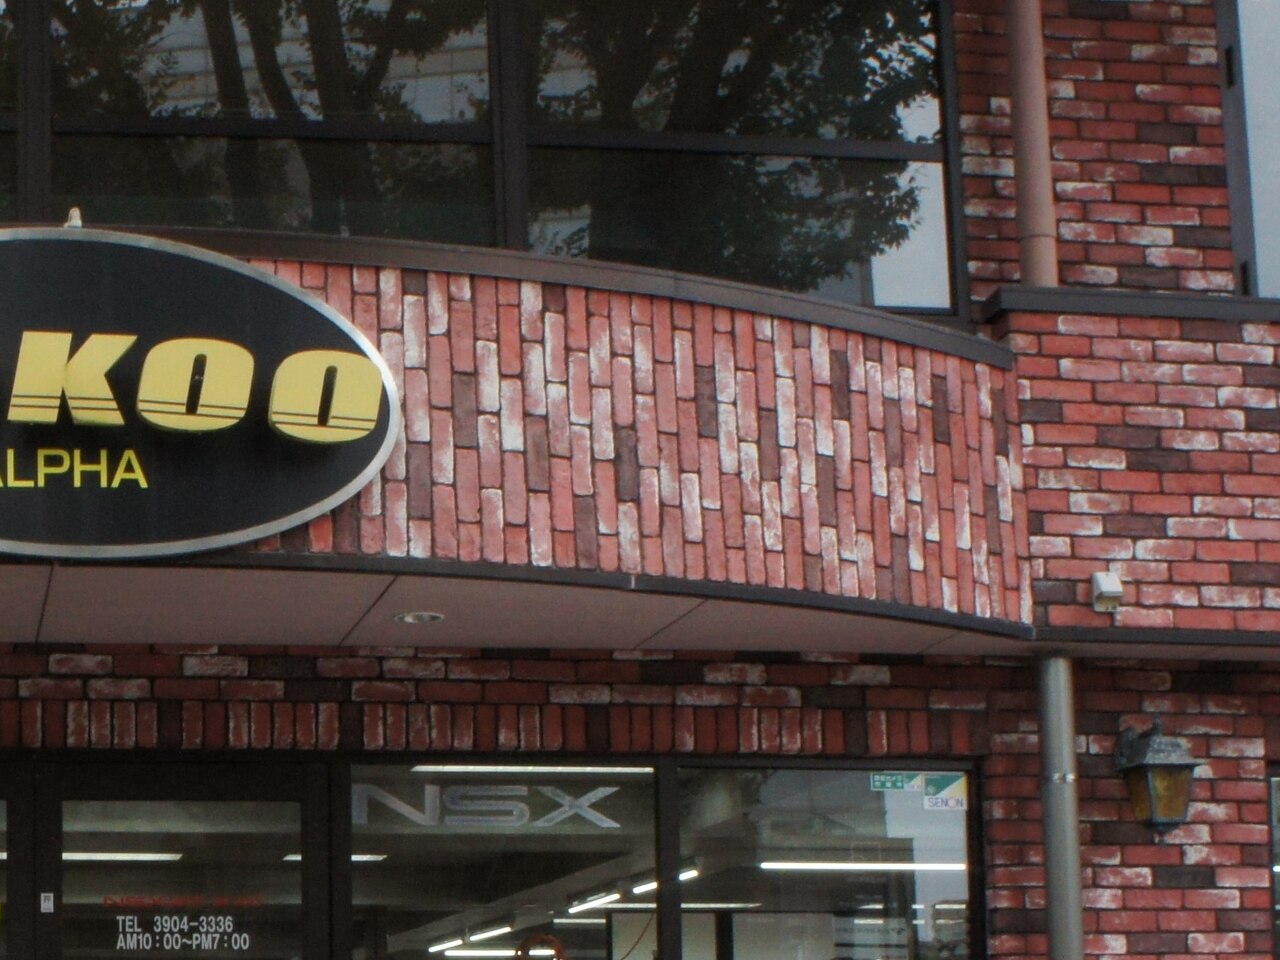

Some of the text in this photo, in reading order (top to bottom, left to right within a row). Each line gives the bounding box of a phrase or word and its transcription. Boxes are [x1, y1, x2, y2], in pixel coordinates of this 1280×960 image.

[351, 784, 621, 828] NSX
[927, 797, 964, 809] SENON
[116, 915, 234, 933] TEL 3904-3336
